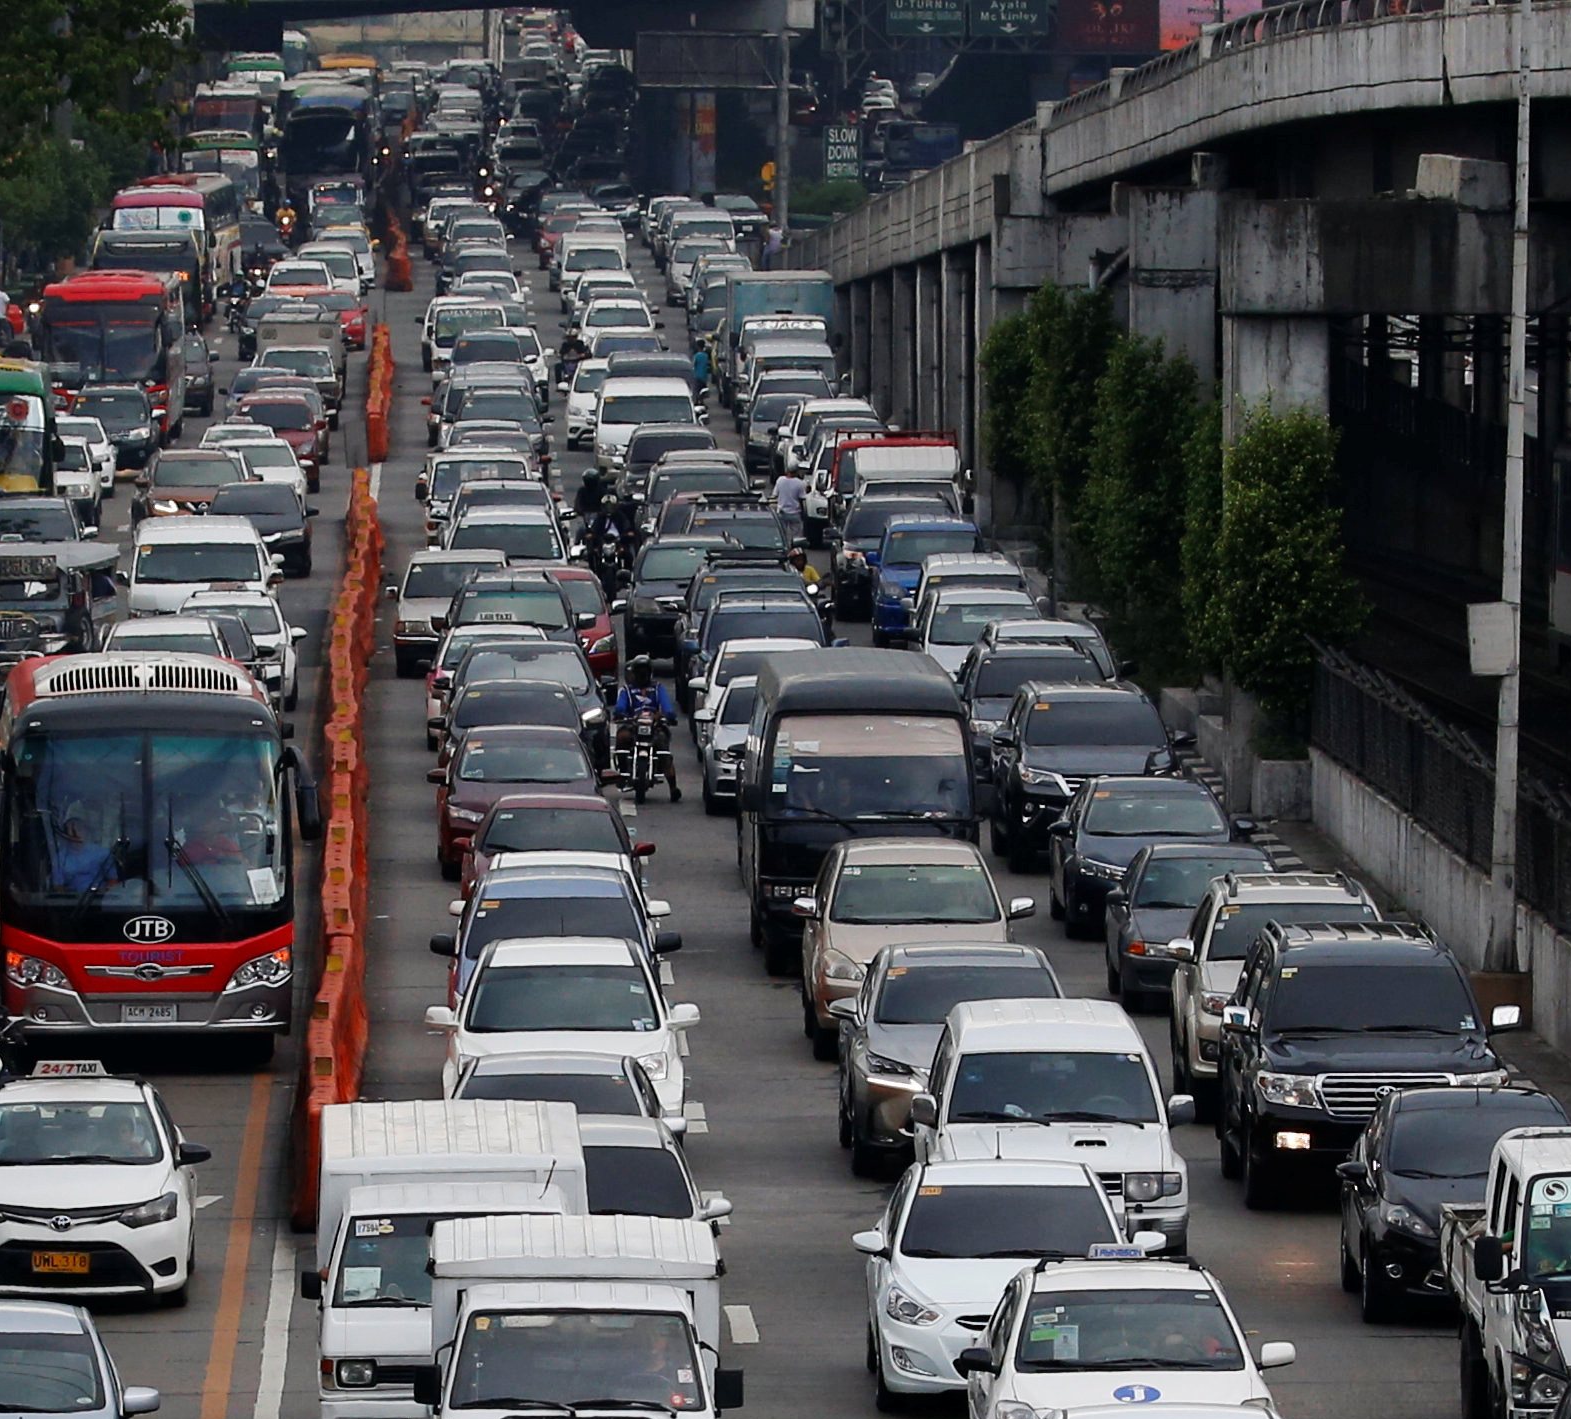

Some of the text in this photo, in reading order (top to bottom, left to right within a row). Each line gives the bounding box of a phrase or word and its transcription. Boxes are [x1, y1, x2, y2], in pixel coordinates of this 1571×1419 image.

[828, 128, 858, 143] SLOW
[828, 145, 858, 160] DOWN
[129, 920, 170, 939] JTB
[118, 951, 184, 963] TOURIST
[127, 1006, 145, 1018] ACM
[75, 1062, 98, 1074] TAXI
